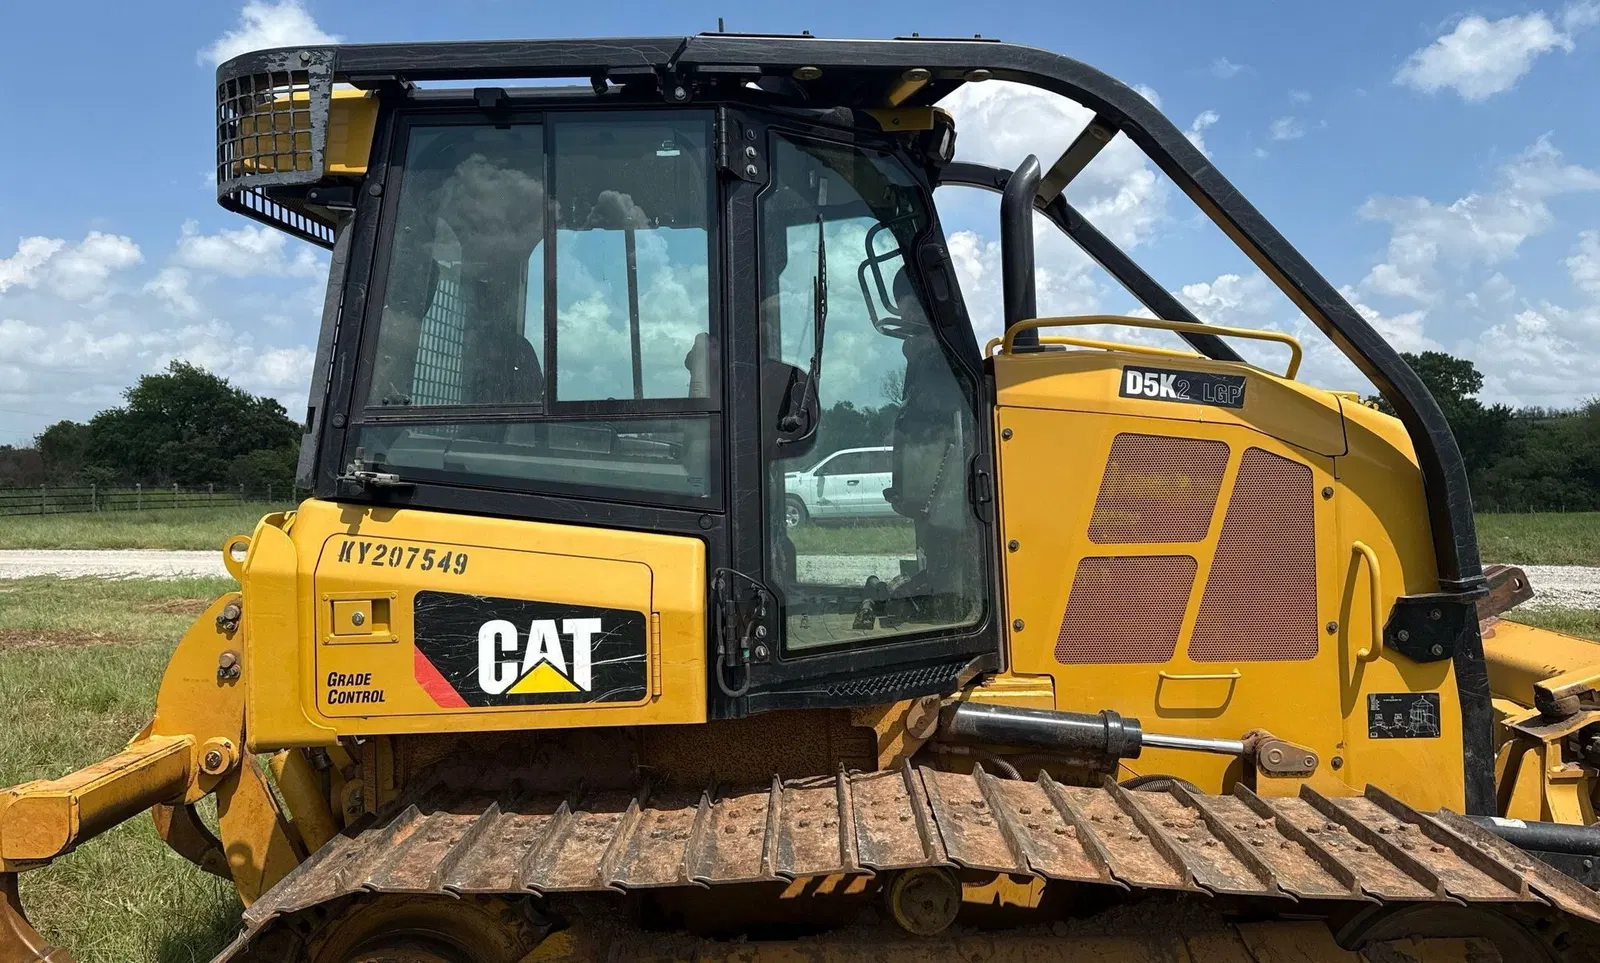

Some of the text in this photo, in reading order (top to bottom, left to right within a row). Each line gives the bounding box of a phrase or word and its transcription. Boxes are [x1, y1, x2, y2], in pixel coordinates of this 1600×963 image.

[1203, 383, 1240, 403] LGP
[338, 540, 468, 575] KY207549
[478, 618, 602, 695] CAT
